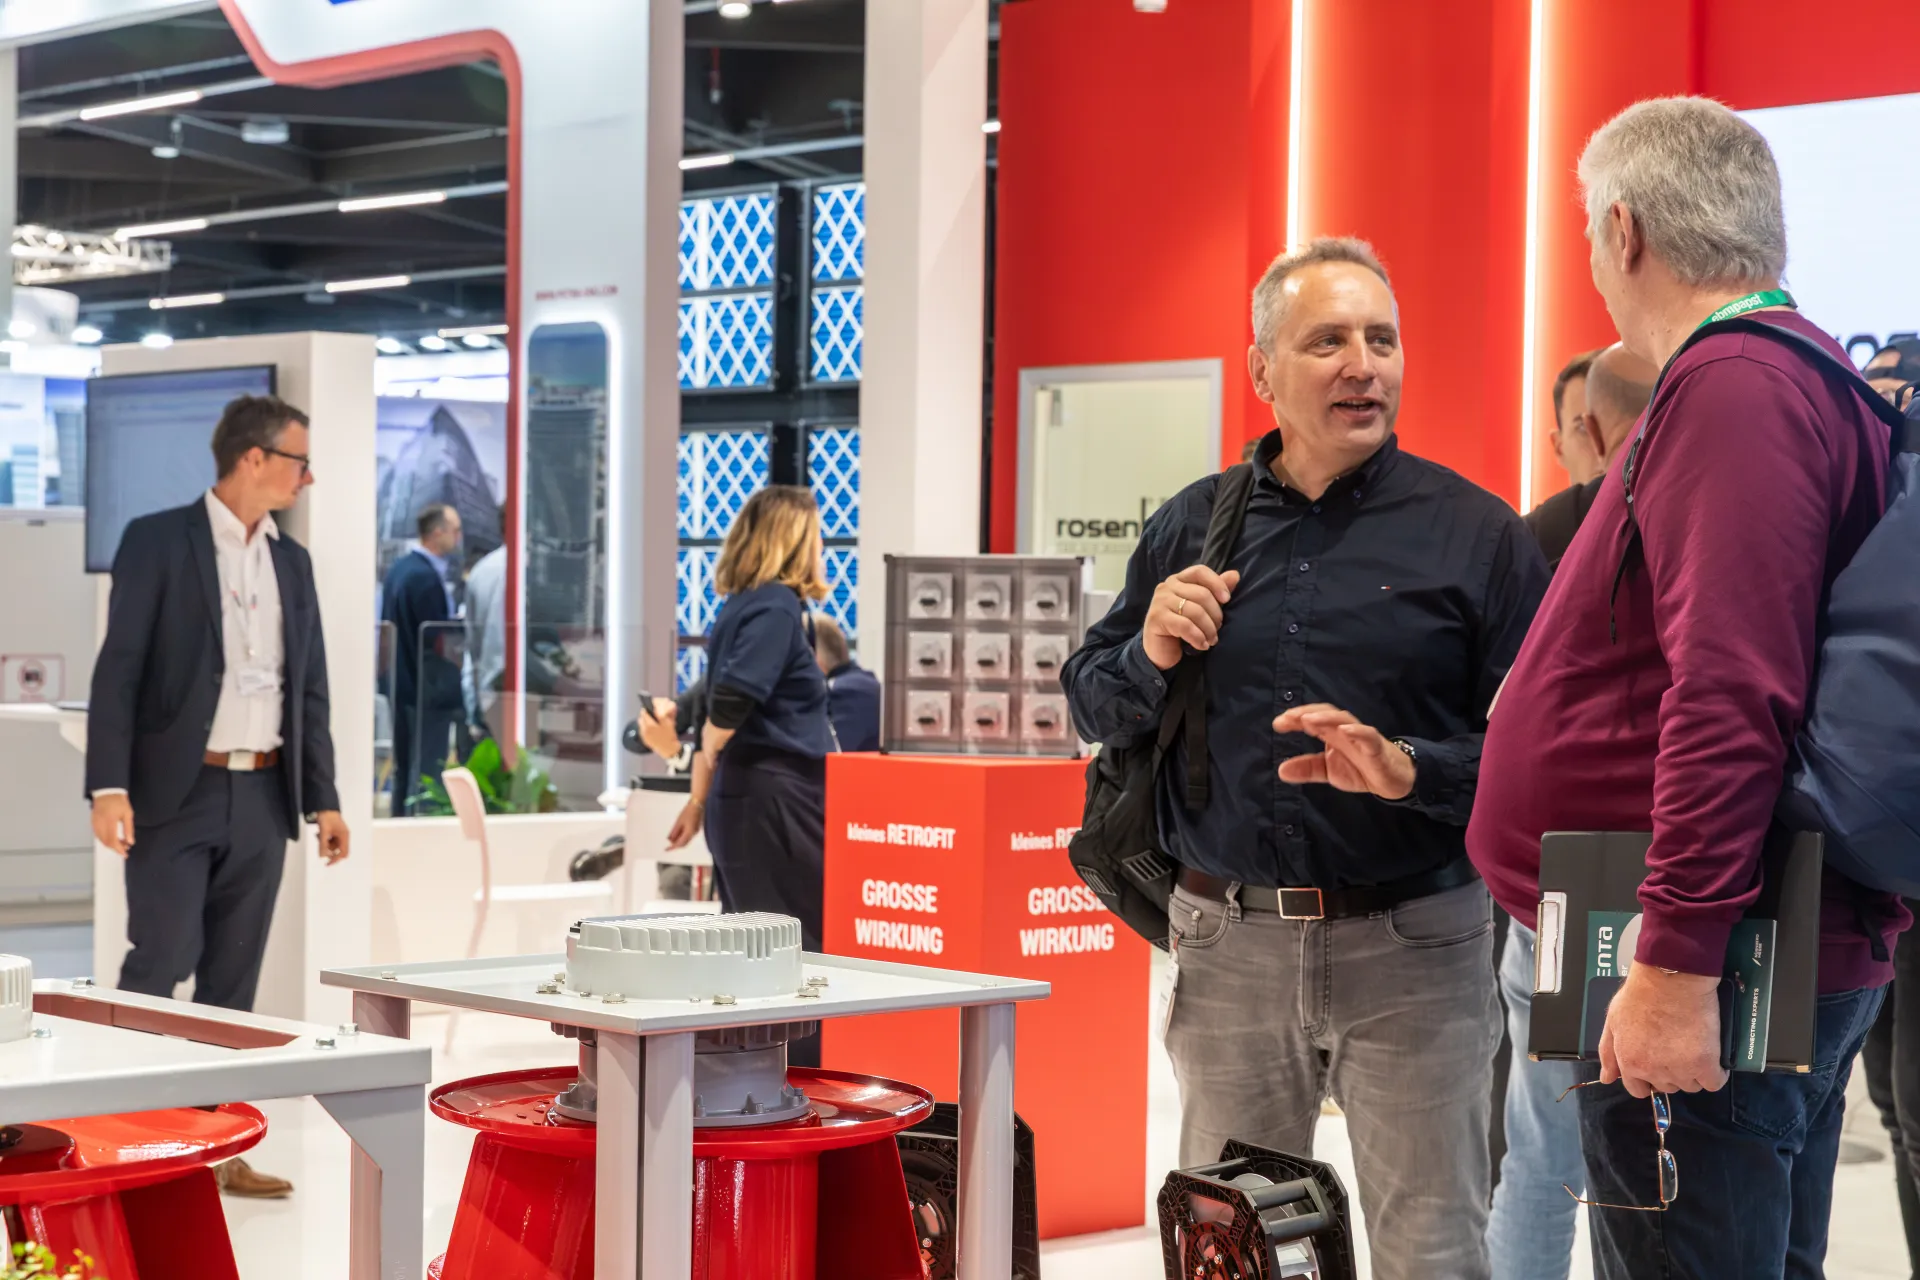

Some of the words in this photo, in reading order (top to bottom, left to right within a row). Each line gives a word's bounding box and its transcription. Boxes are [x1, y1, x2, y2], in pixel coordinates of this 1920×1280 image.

[1711, 293, 1763, 322] ebmpapst
[847, 822, 886, 844] kleines
[887, 823, 956, 850] RETROFIT
[1011, 832, 1054, 851] kleines
[862, 878, 938, 913] GROSSE
[855, 917, 944, 955] WIRKUNG
[1020, 923, 1114, 956] WIRKUNG
[1747, 1017, 1757, 1060] CONNECTING
[1752, 987, 1760, 1017] EXPERTS
